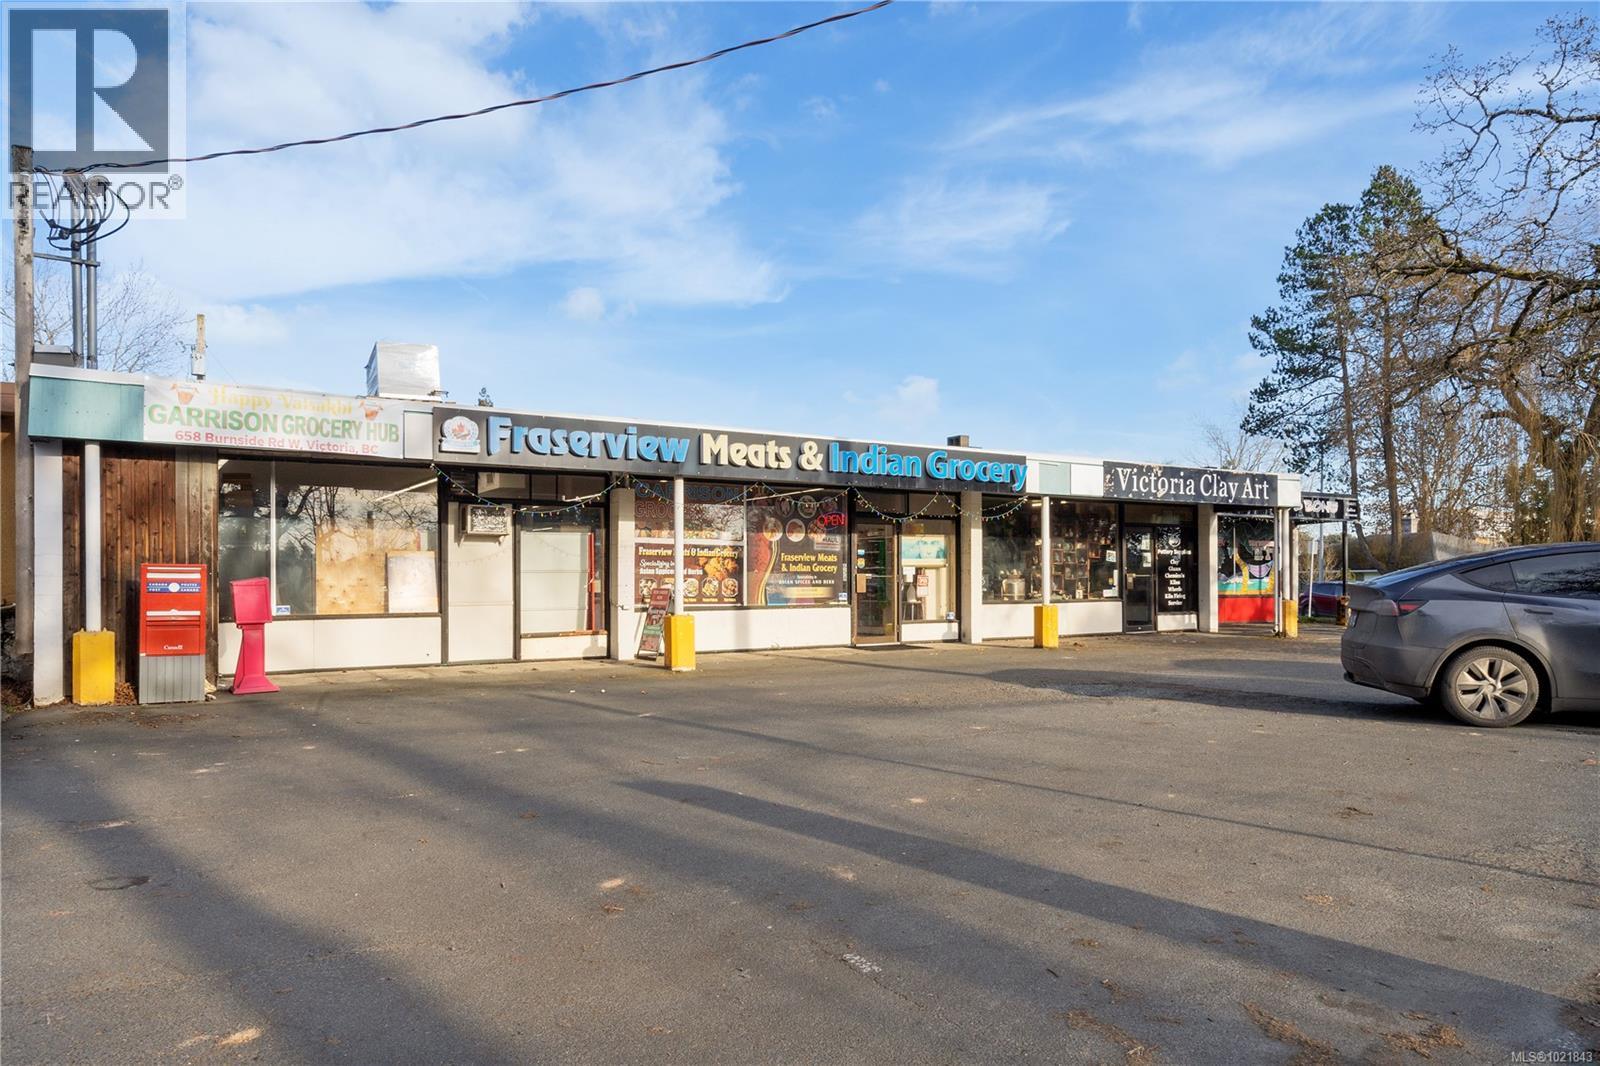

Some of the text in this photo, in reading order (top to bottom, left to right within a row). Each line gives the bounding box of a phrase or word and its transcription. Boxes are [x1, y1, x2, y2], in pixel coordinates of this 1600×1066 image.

[209, 384, 273, 409] Happy
[147, 403, 400, 443] GARRISON GROCERY HUB
[175, 430, 379, 455] 658 Burnside Rd W, Victoria, BC
[487, 415, 690, 463] Fraserview
[700, 432, 792, 469] Meats
[797, 440, 824, 471] &
[828, 442, 922, 479] Indian
[926, 450, 1028, 492] Grocery
[1115, 467, 1269, 502] Victoria Clay Art
[816, 512, 845, 529] OPEN
[638, 546, 673, 556] Fraserview
[781, 552, 838, 562] Fraserview Meats
[781, 563, 788, 572] &
[789, 563, 811, 572] Indian
[812, 563, 838, 574] Grocery
